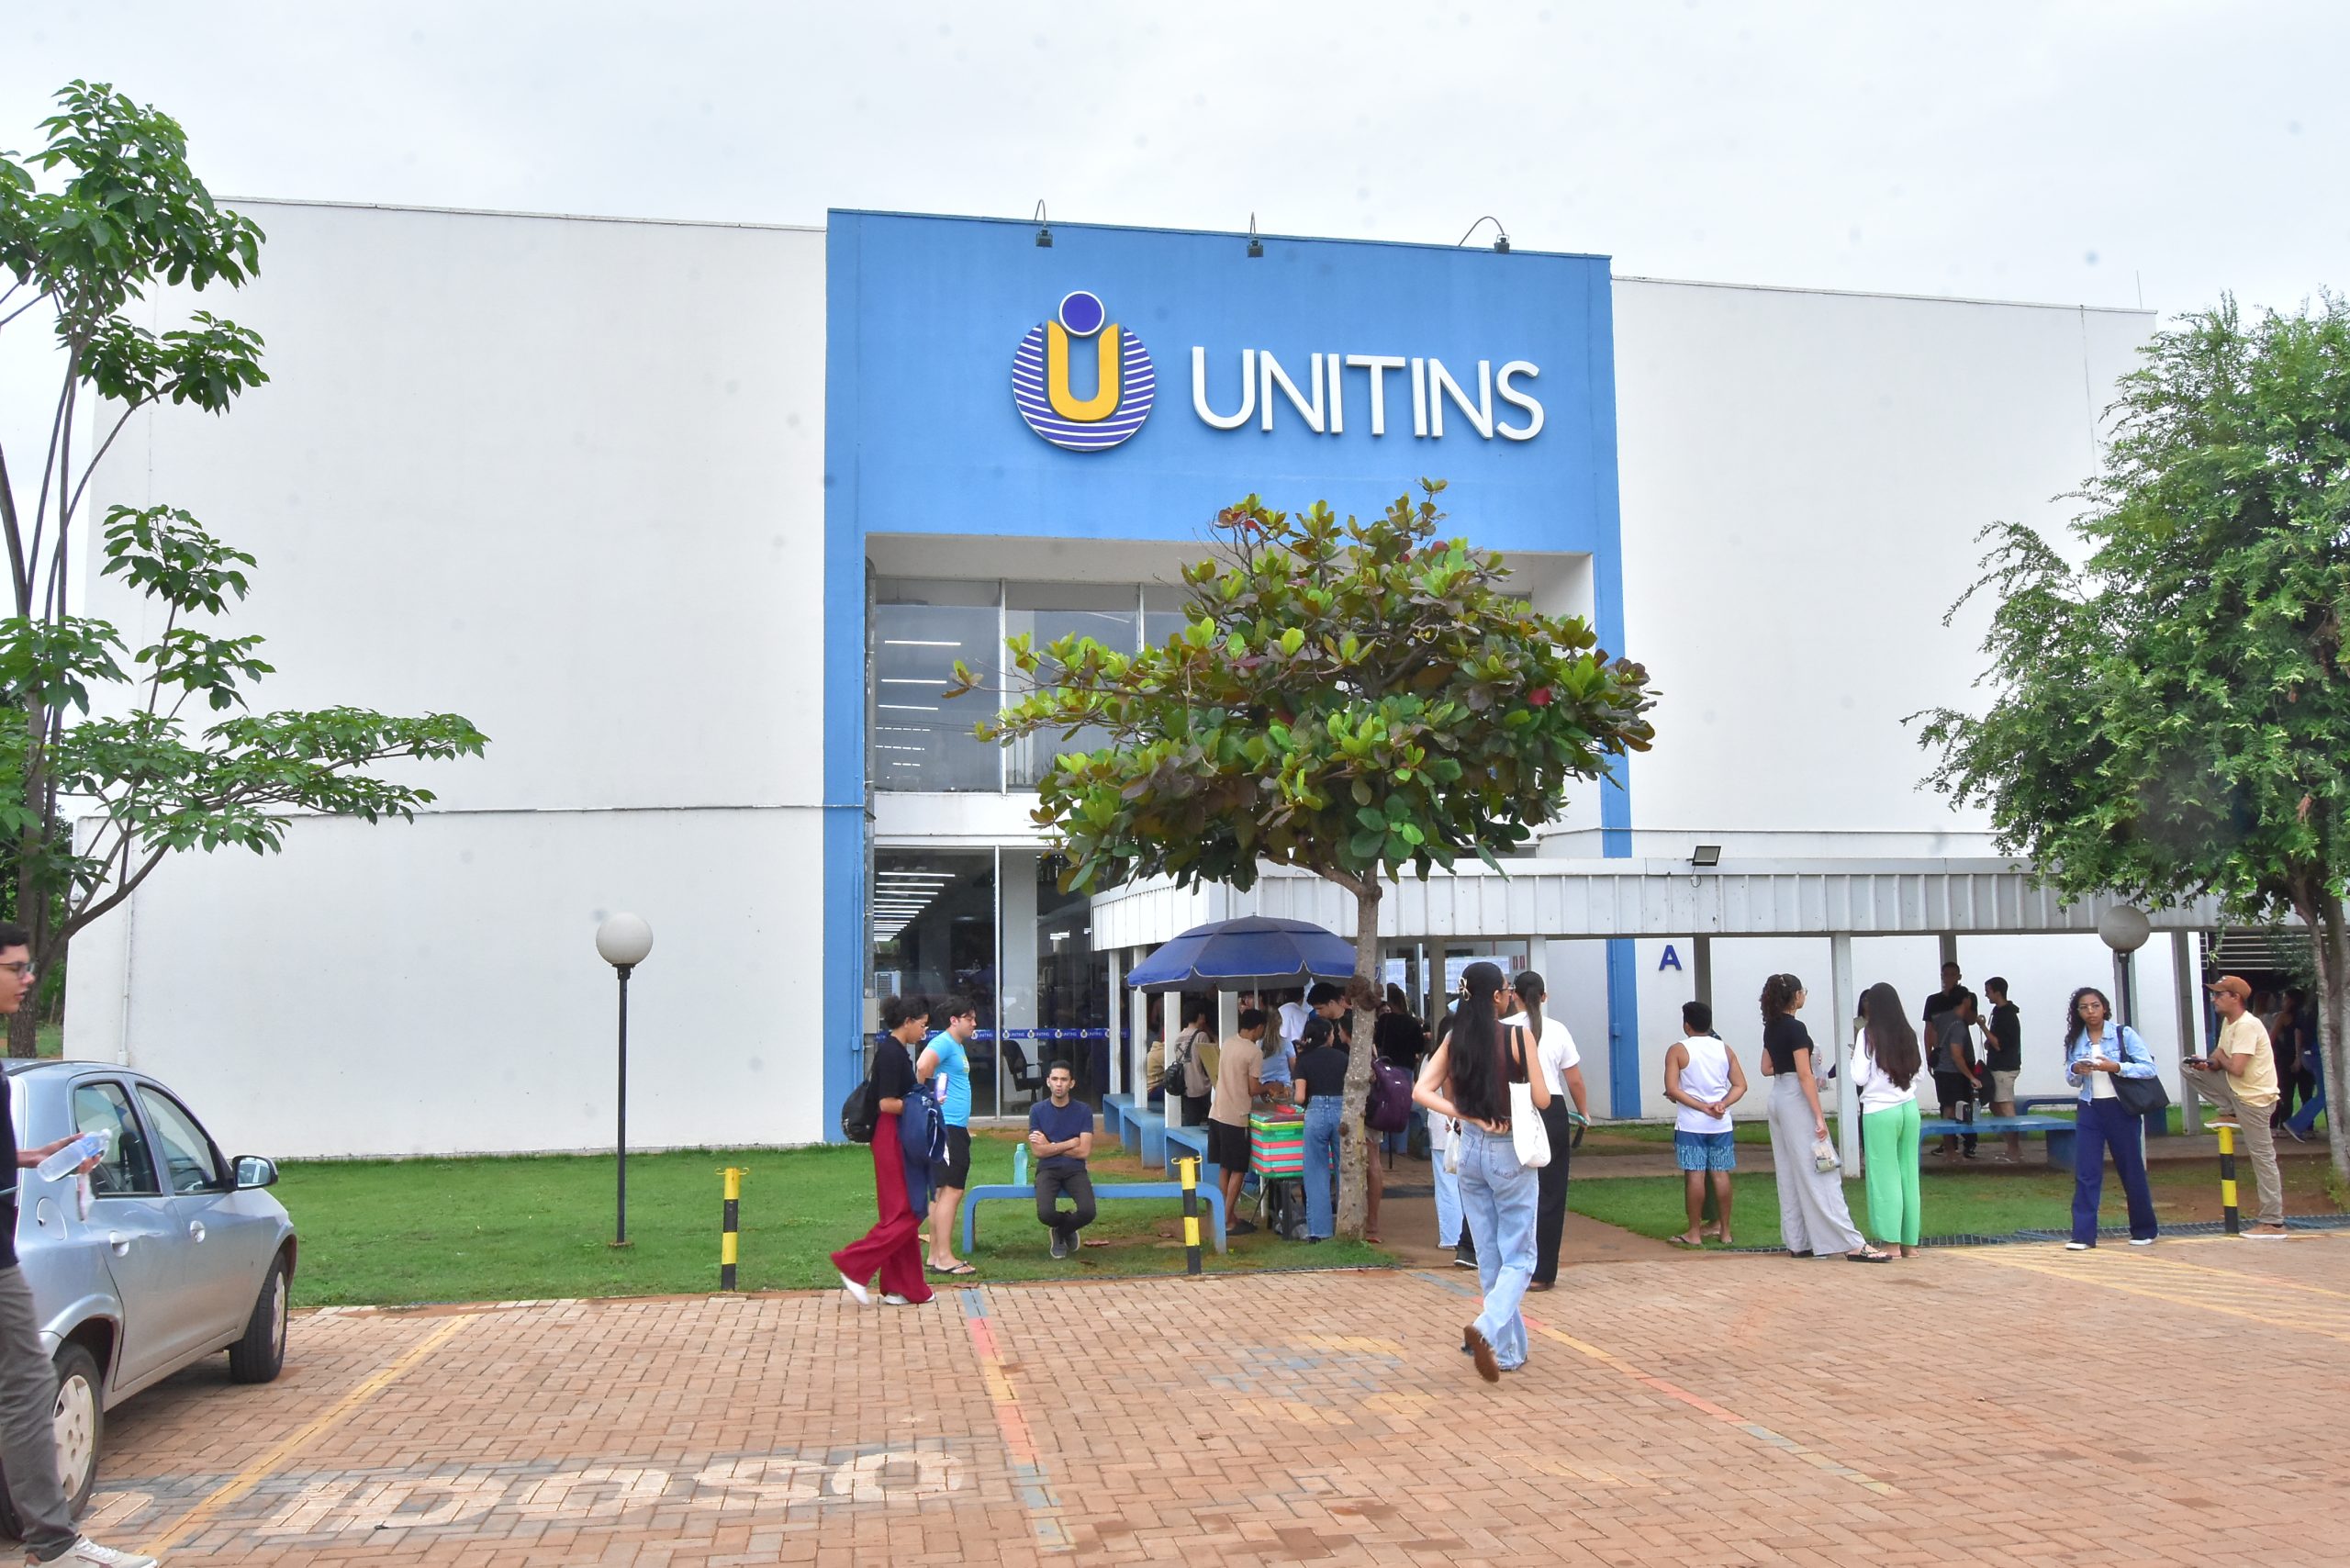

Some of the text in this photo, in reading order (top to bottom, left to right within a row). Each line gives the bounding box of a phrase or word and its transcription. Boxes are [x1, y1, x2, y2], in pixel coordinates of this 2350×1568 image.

[1192, 345, 1546, 442] UNITINS
[1658, 944, 1683, 971] A
[251, 1450, 964, 1537] IDOSO
